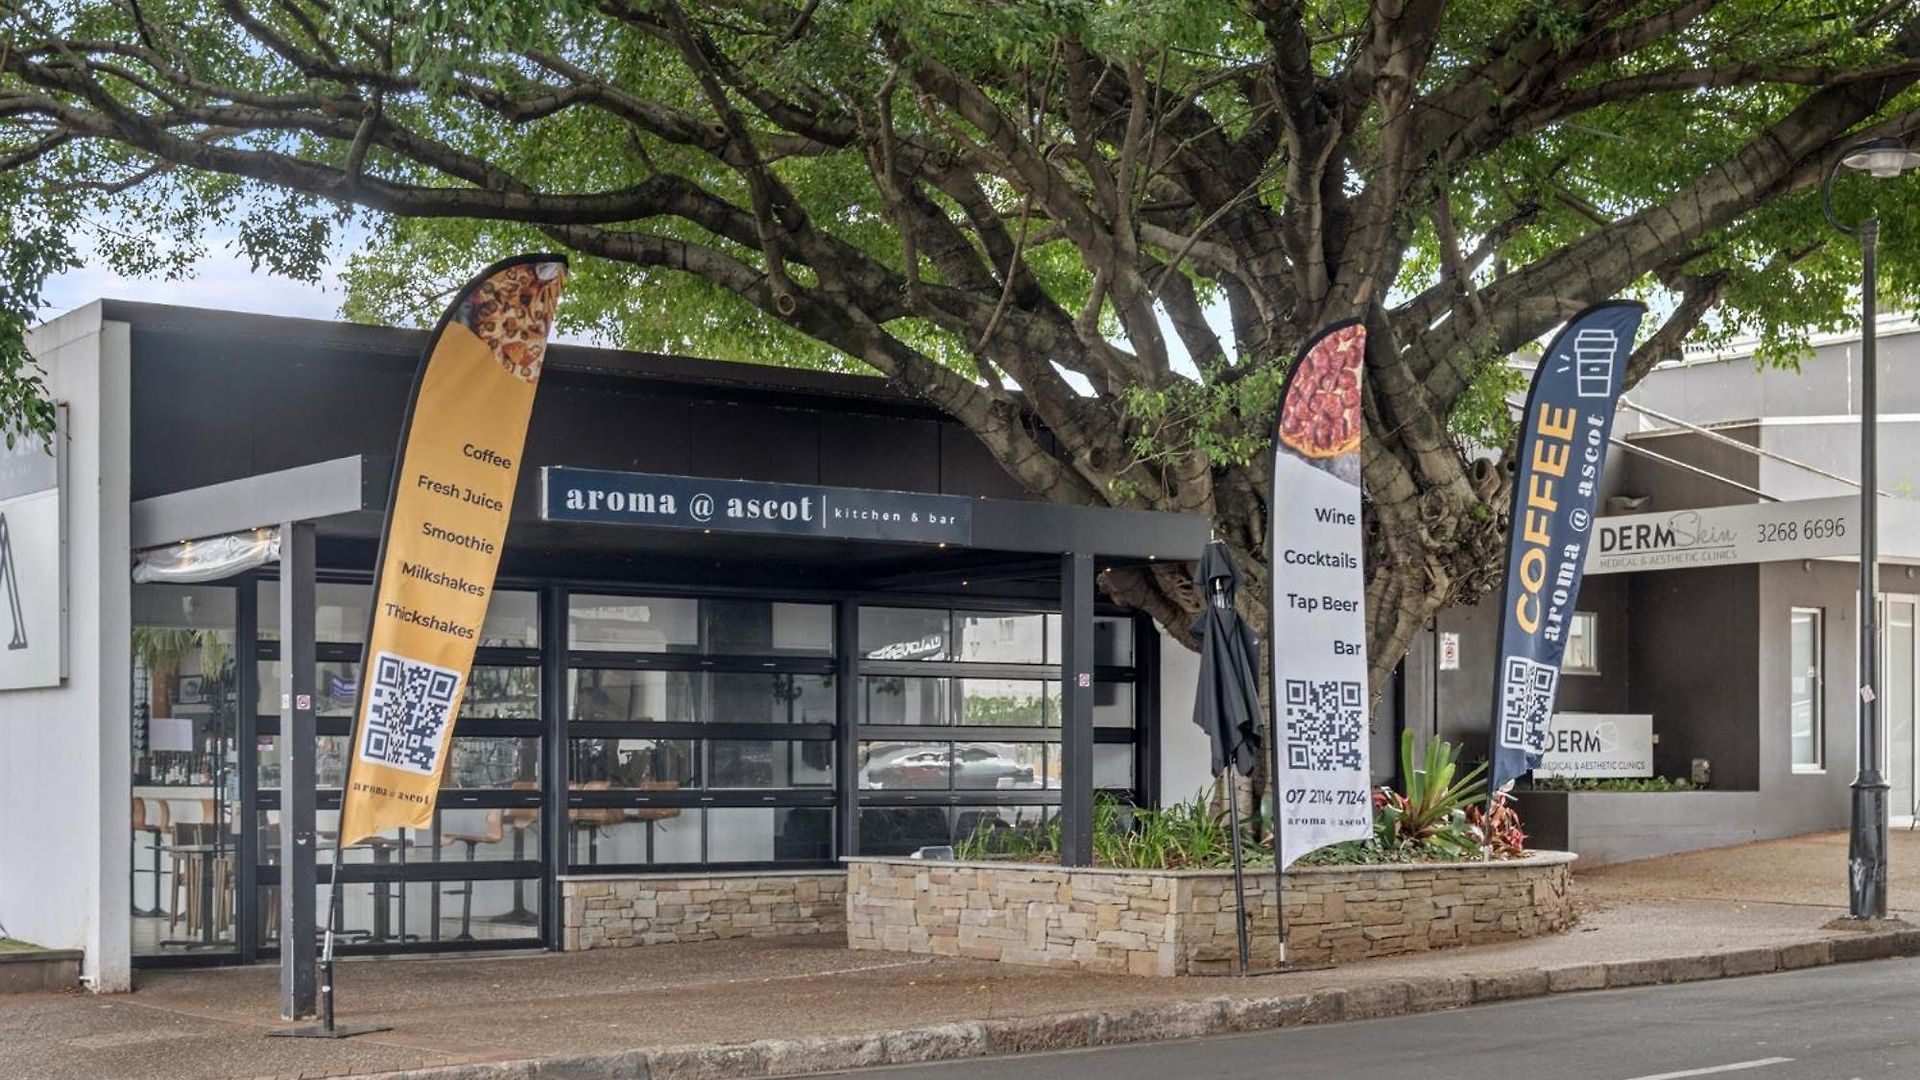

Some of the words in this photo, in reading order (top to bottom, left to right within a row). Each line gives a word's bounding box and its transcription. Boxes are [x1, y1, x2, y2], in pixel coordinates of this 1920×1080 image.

[463, 442, 512, 470] Coffee
[1578, 413, 1605, 497] ascot
[417, 474, 460, 500] Fresh
[462, 488, 503, 512] Juice
[566, 487, 678, 515] aroma
[689, 493, 715, 522] @
[727, 495, 814, 522] ascot
[834, 507, 901, 522] kitchen
[911, 512, 920, 523] &
[929, 512, 957, 525] bar
[1315, 508, 1356, 526] Wine
[1516, 403, 1577, 635] COFFEE
[1569, 507, 1590, 532] @
[421, 522, 494, 554] Smoothie
[1600, 523, 1676, 551] DERM
[1757, 521, 1798, 543] 3268
[1803, 517, 1846, 540] 6696
[1284, 550, 1357, 568] Cocktails
[1701, 550, 1738, 562] CLINICS
[402, 561, 485, 597] Milkshakes
[1544, 543, 1580, 642] aroma
[1287, 593, 1318, 613] Tap
[1323, 596, 1358, 612] Beer
[386, 602, 474, 639] Thickshakes
[1334, 640, 1362, 655] Bar
[1545, 730, 1602, 752] DERM
[1286, 789, 1306, 804] 07
[1309, 790, 1334, 805] 2114
[1336, 790, 1366, 805] 7124
